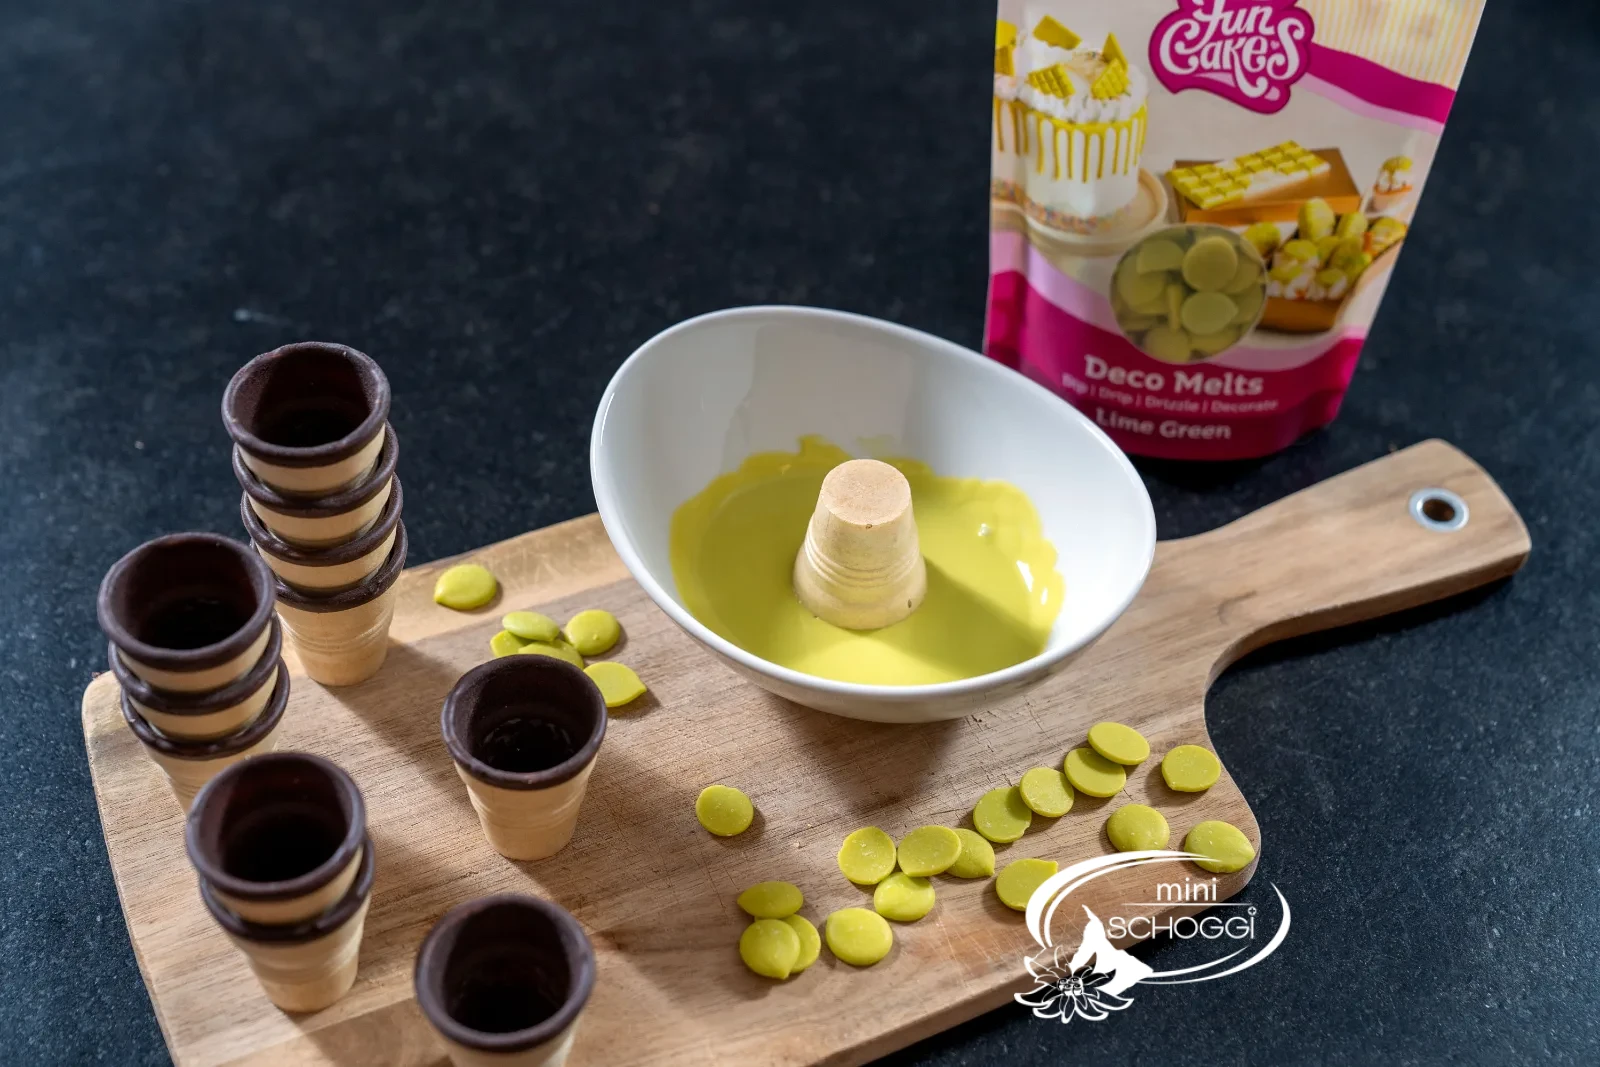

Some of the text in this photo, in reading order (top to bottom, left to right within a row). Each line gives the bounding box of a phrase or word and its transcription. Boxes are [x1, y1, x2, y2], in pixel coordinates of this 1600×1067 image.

[1174, 0, 1276, 55] Fun
[1084, 354, 1264, 396] Deco Melts
[1096, 407, 1231, 439] Lime Green
[1211, 399, 1278, 413] Decorate
